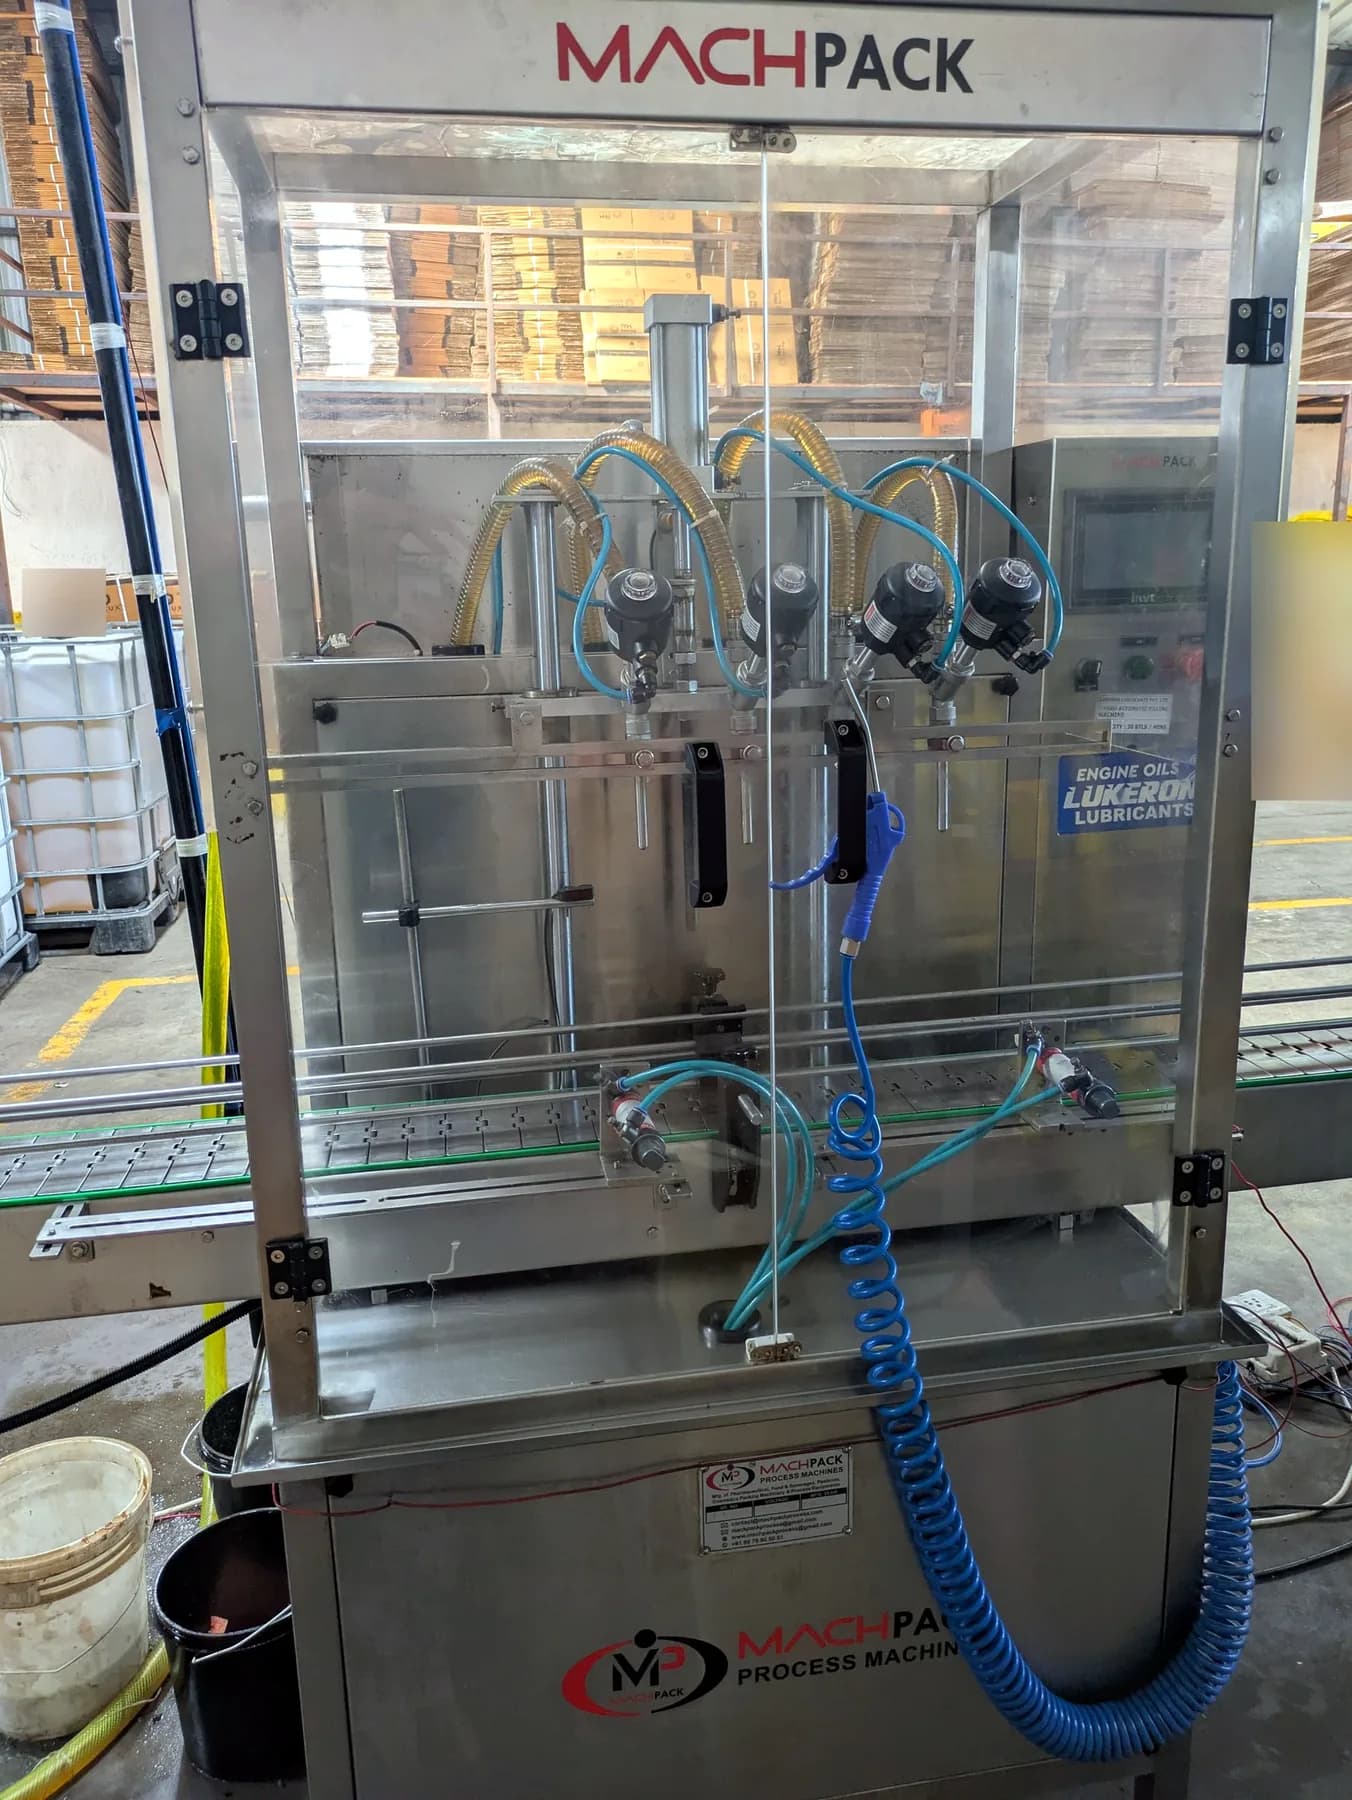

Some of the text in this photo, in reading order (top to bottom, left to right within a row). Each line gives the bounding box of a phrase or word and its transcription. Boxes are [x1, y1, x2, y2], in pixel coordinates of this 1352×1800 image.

[556, 22, 975, 93] MACHPACK
[1076, 762, 1180, 782] ENGINE OILS
[1063, 777, 1196, 809] LUKERON
[1074, 802, 1194, 825] LUBRICANTS
[760, 1454, 843, 1475] MACHPACK
[760, 1466, 844, 1484] PROCESS MACHINES
[737, 1607, 952, 1661] MACHPA
[737, 1641, 959, 1686] PROCESS MACHIN
